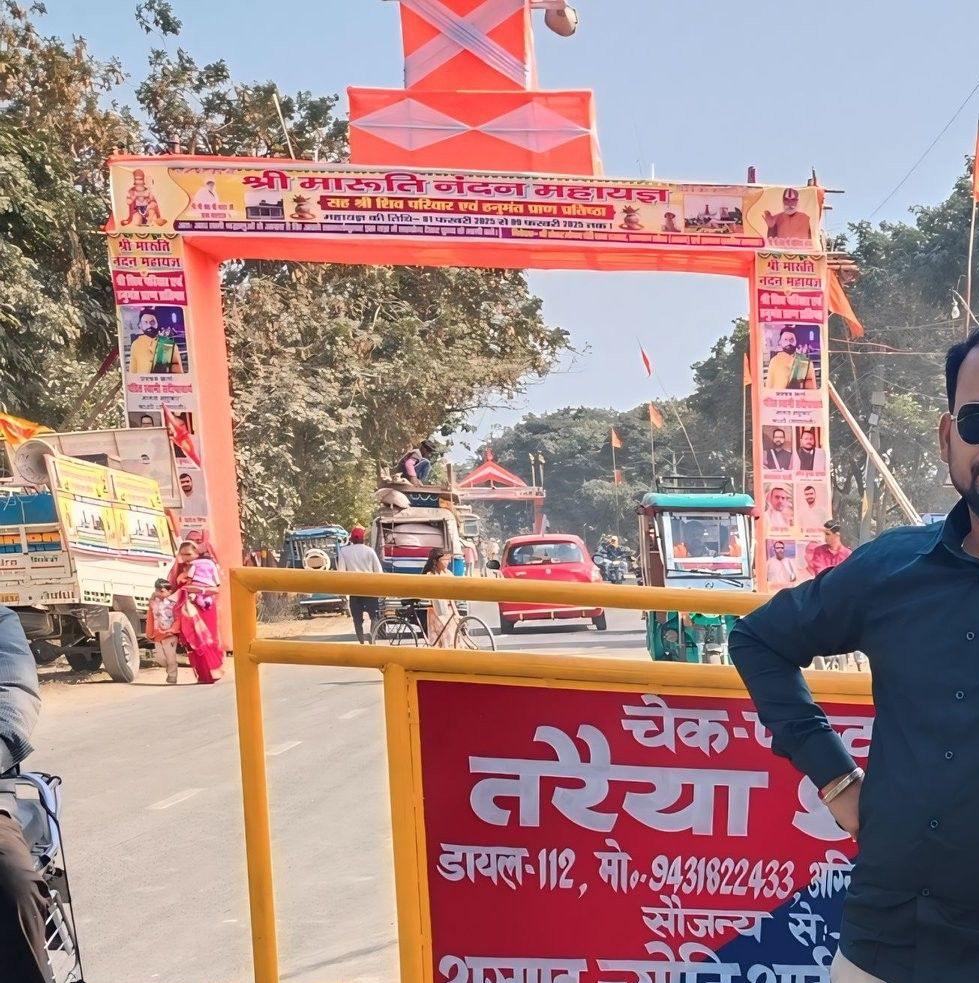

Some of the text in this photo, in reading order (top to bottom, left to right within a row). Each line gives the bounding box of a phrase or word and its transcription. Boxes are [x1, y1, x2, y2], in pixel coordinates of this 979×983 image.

[242, 170, 291, 190] श्री
[432, 175, 527, 198] नंदन
[533, 183, 671, 205] महायज्ञ
[354, 196, 372, 209] श्री
[376, 196, 404, 209] शिव
[408, 197, 454, 212] परिवार
[641, 895, 774, 943] सौजन्य
